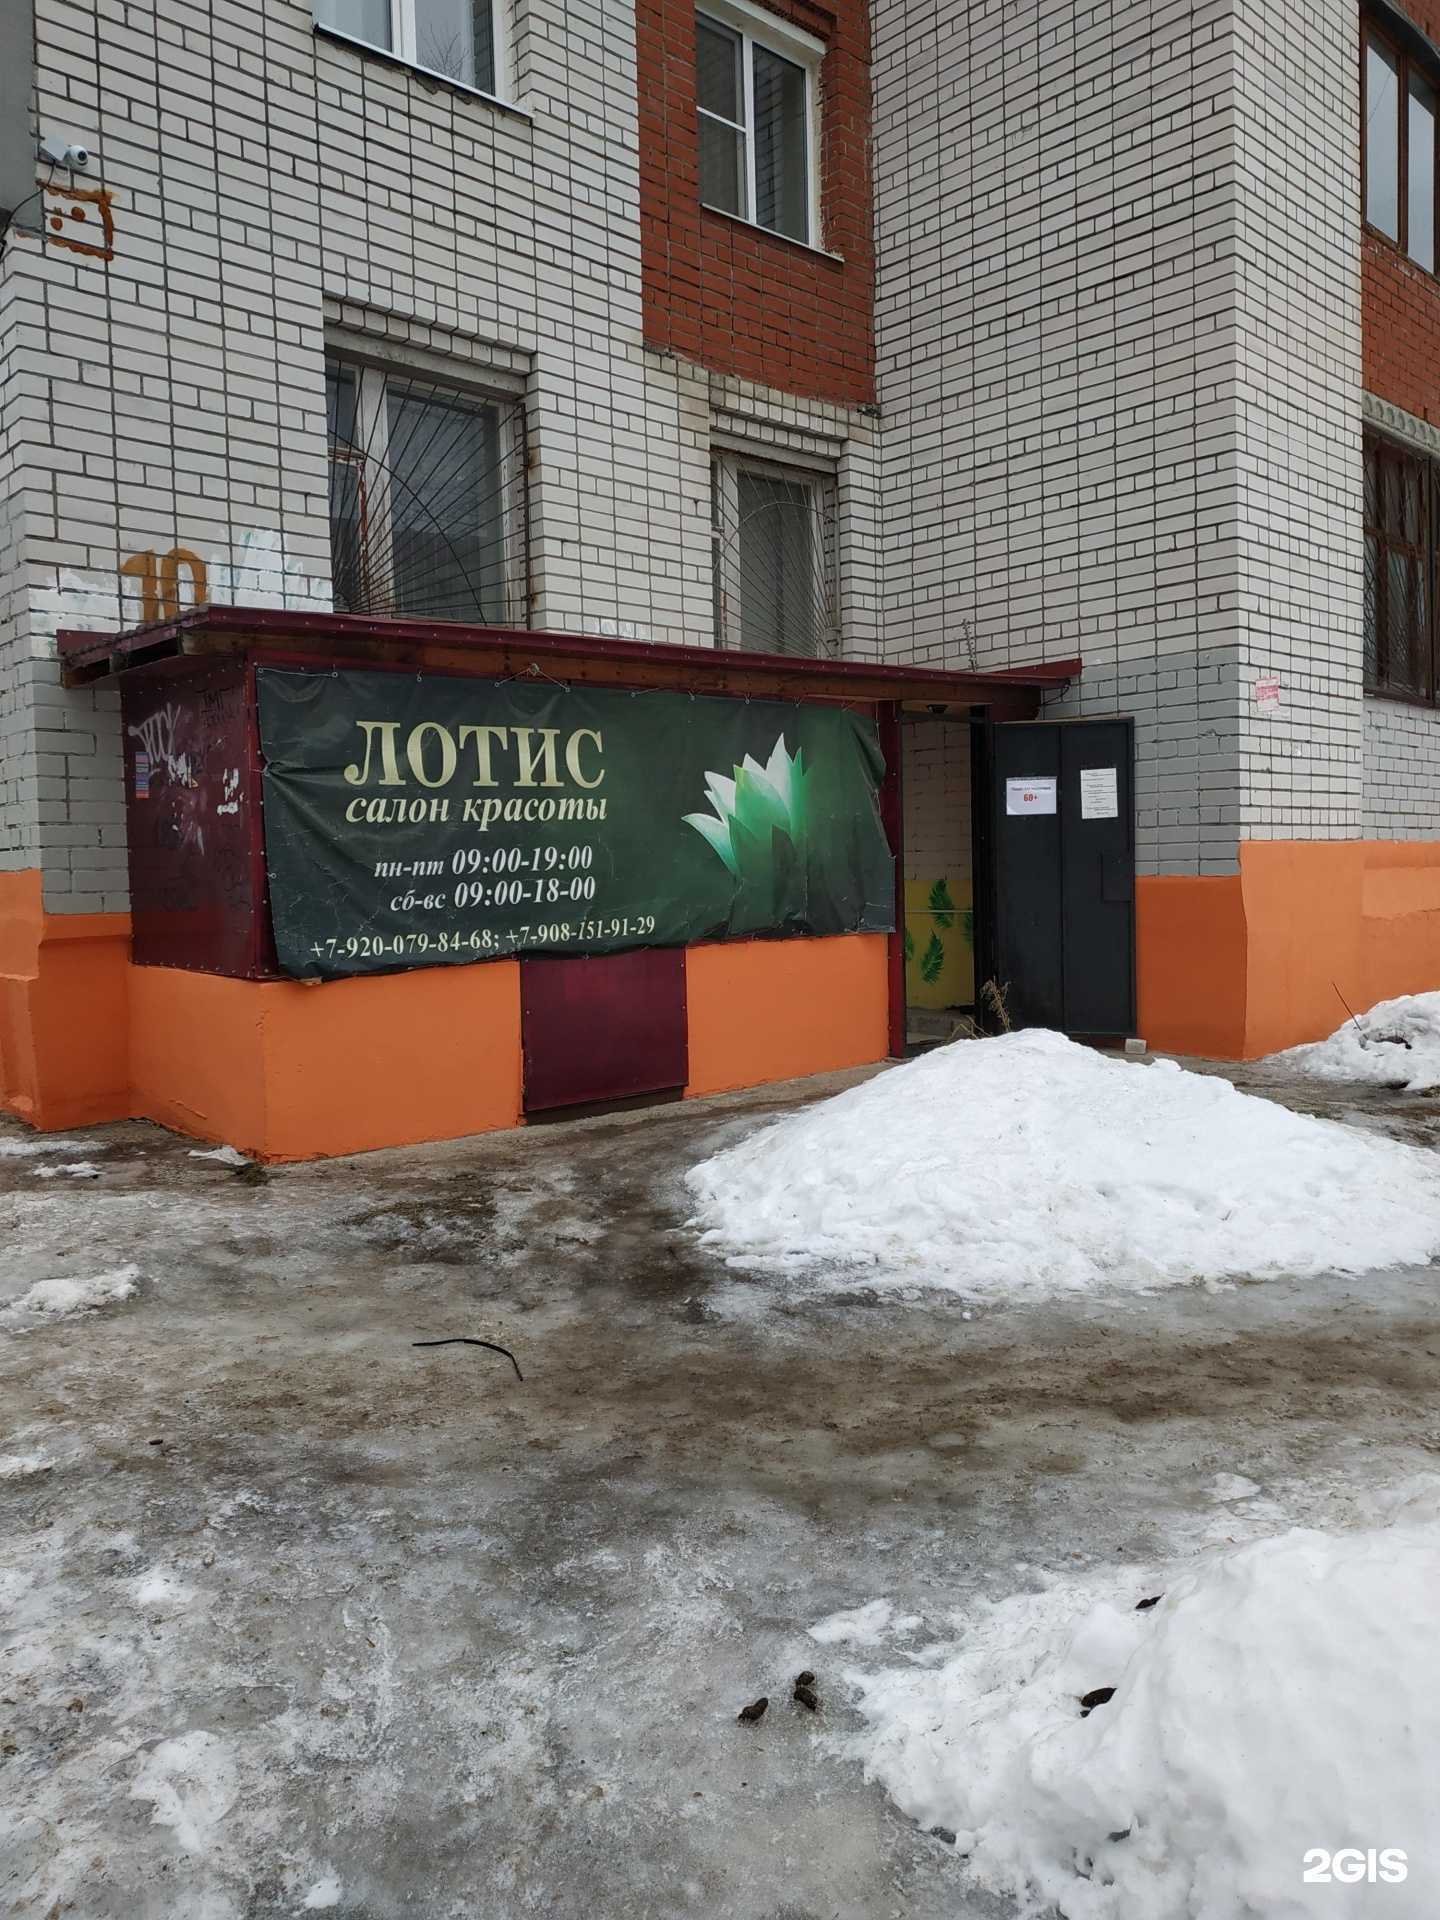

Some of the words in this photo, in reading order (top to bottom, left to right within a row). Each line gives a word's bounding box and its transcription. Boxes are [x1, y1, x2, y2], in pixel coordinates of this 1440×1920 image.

[343, 720, 606, 789] ЛОТИС
[345, 796, 451, 824] салон
[461, 796, 608, 832] красоты
[373, 859, 445, 878] пн-пт
[451, 845, 593, 875] 09:00-19:00
[389, 889, 447, 912] сб-вс
[453, 876, 597, 909] 09:00-18-00
[309, 928, 500, 959] +7-920-079-84-68;
[505, 915, 656, 945] +7-908-151-91-29
